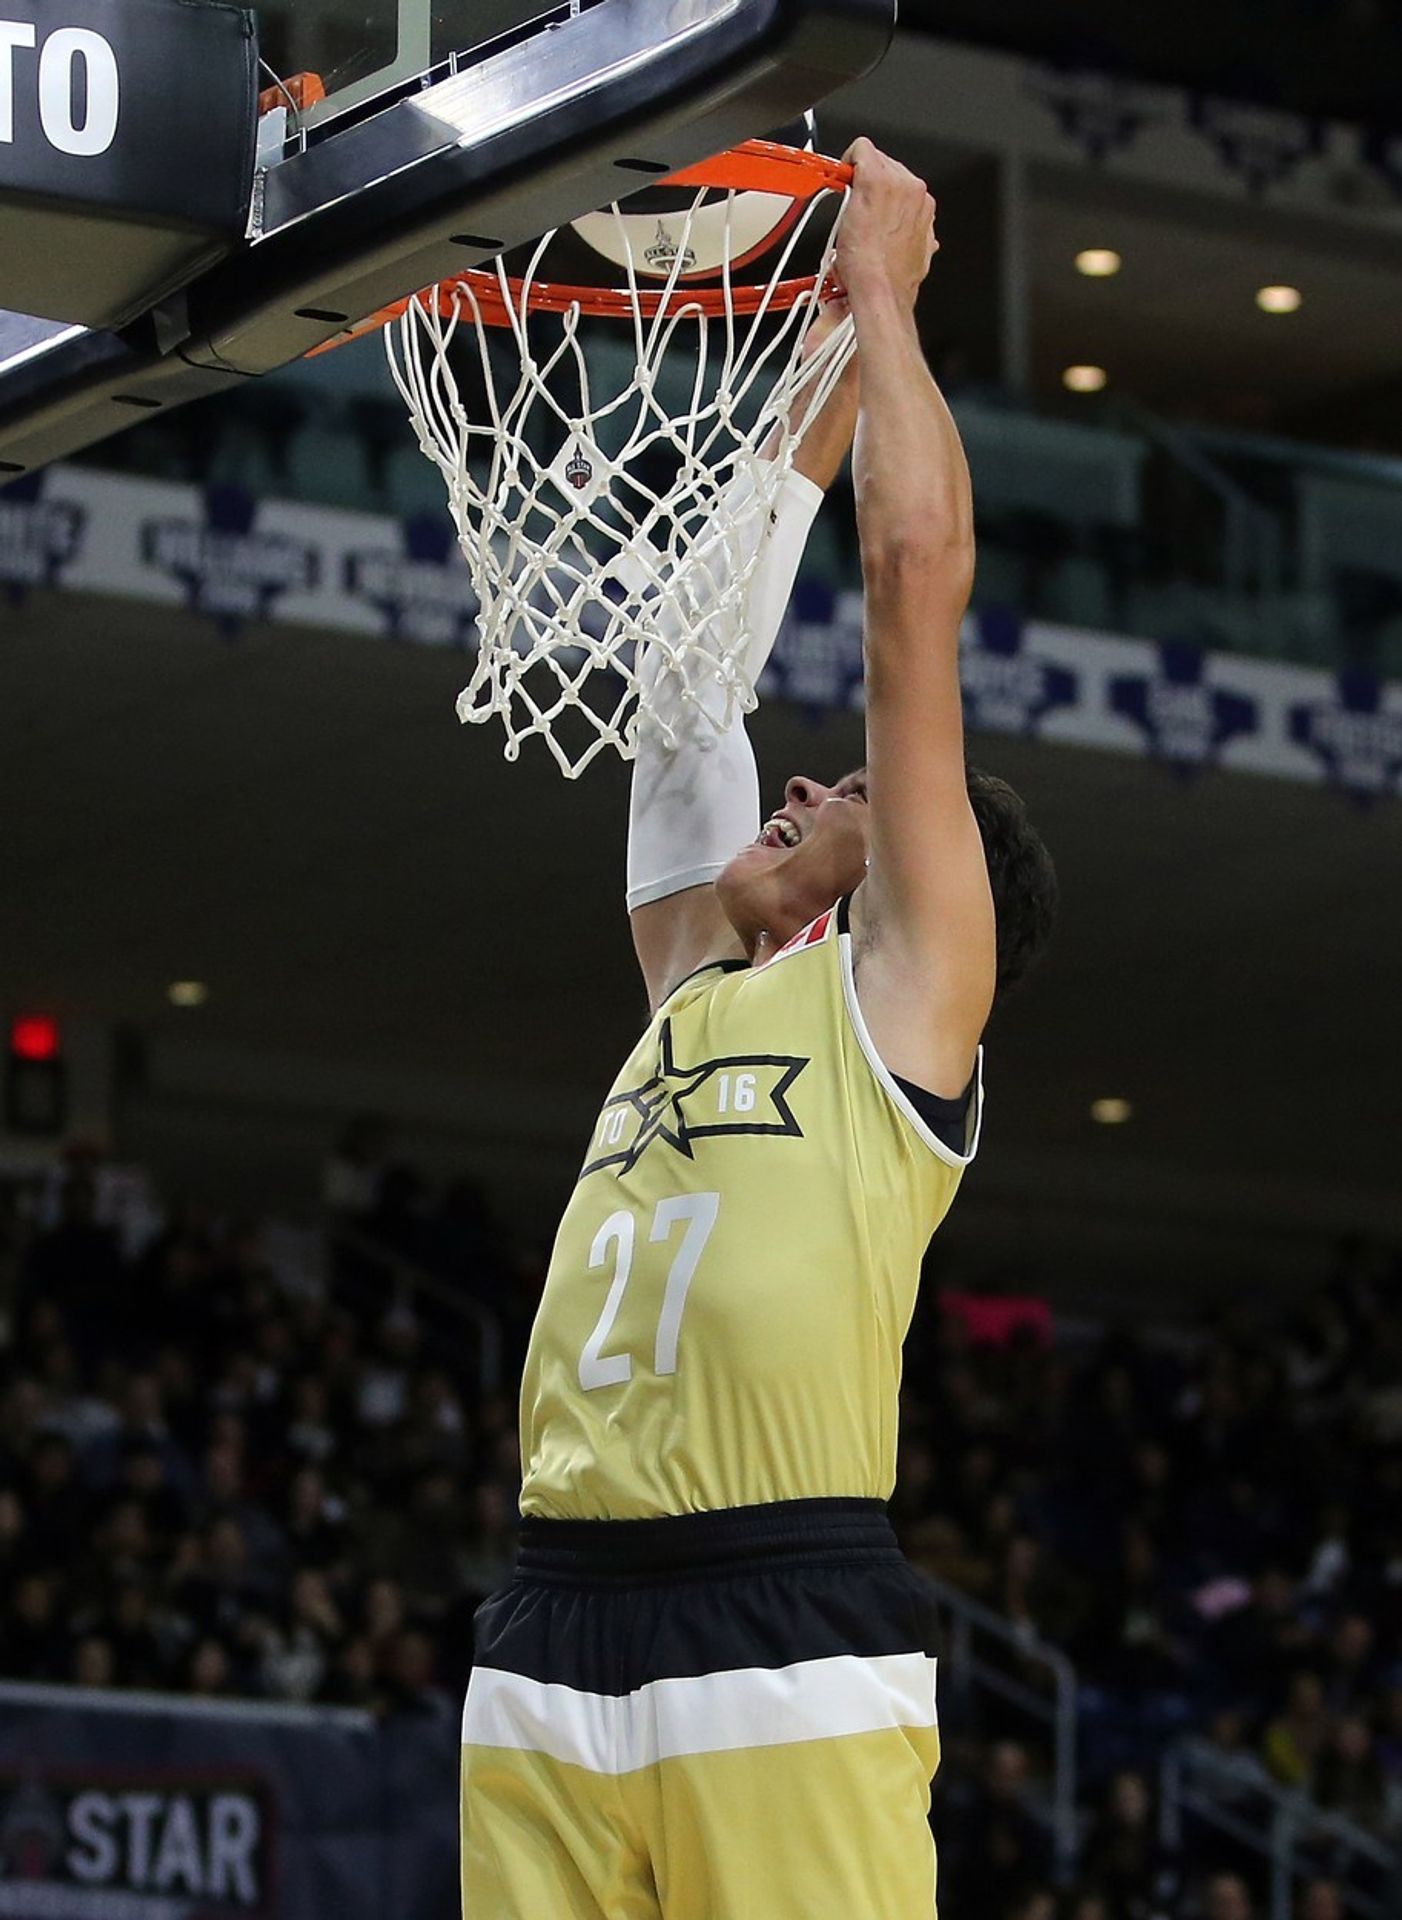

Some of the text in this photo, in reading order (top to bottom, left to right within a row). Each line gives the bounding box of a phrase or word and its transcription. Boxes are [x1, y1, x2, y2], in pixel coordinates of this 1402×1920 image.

[718, 1073, 757, 1113] 16
[578, 1191, 720, 1391] 27
[68, 1793, 260, 1903] STAR
